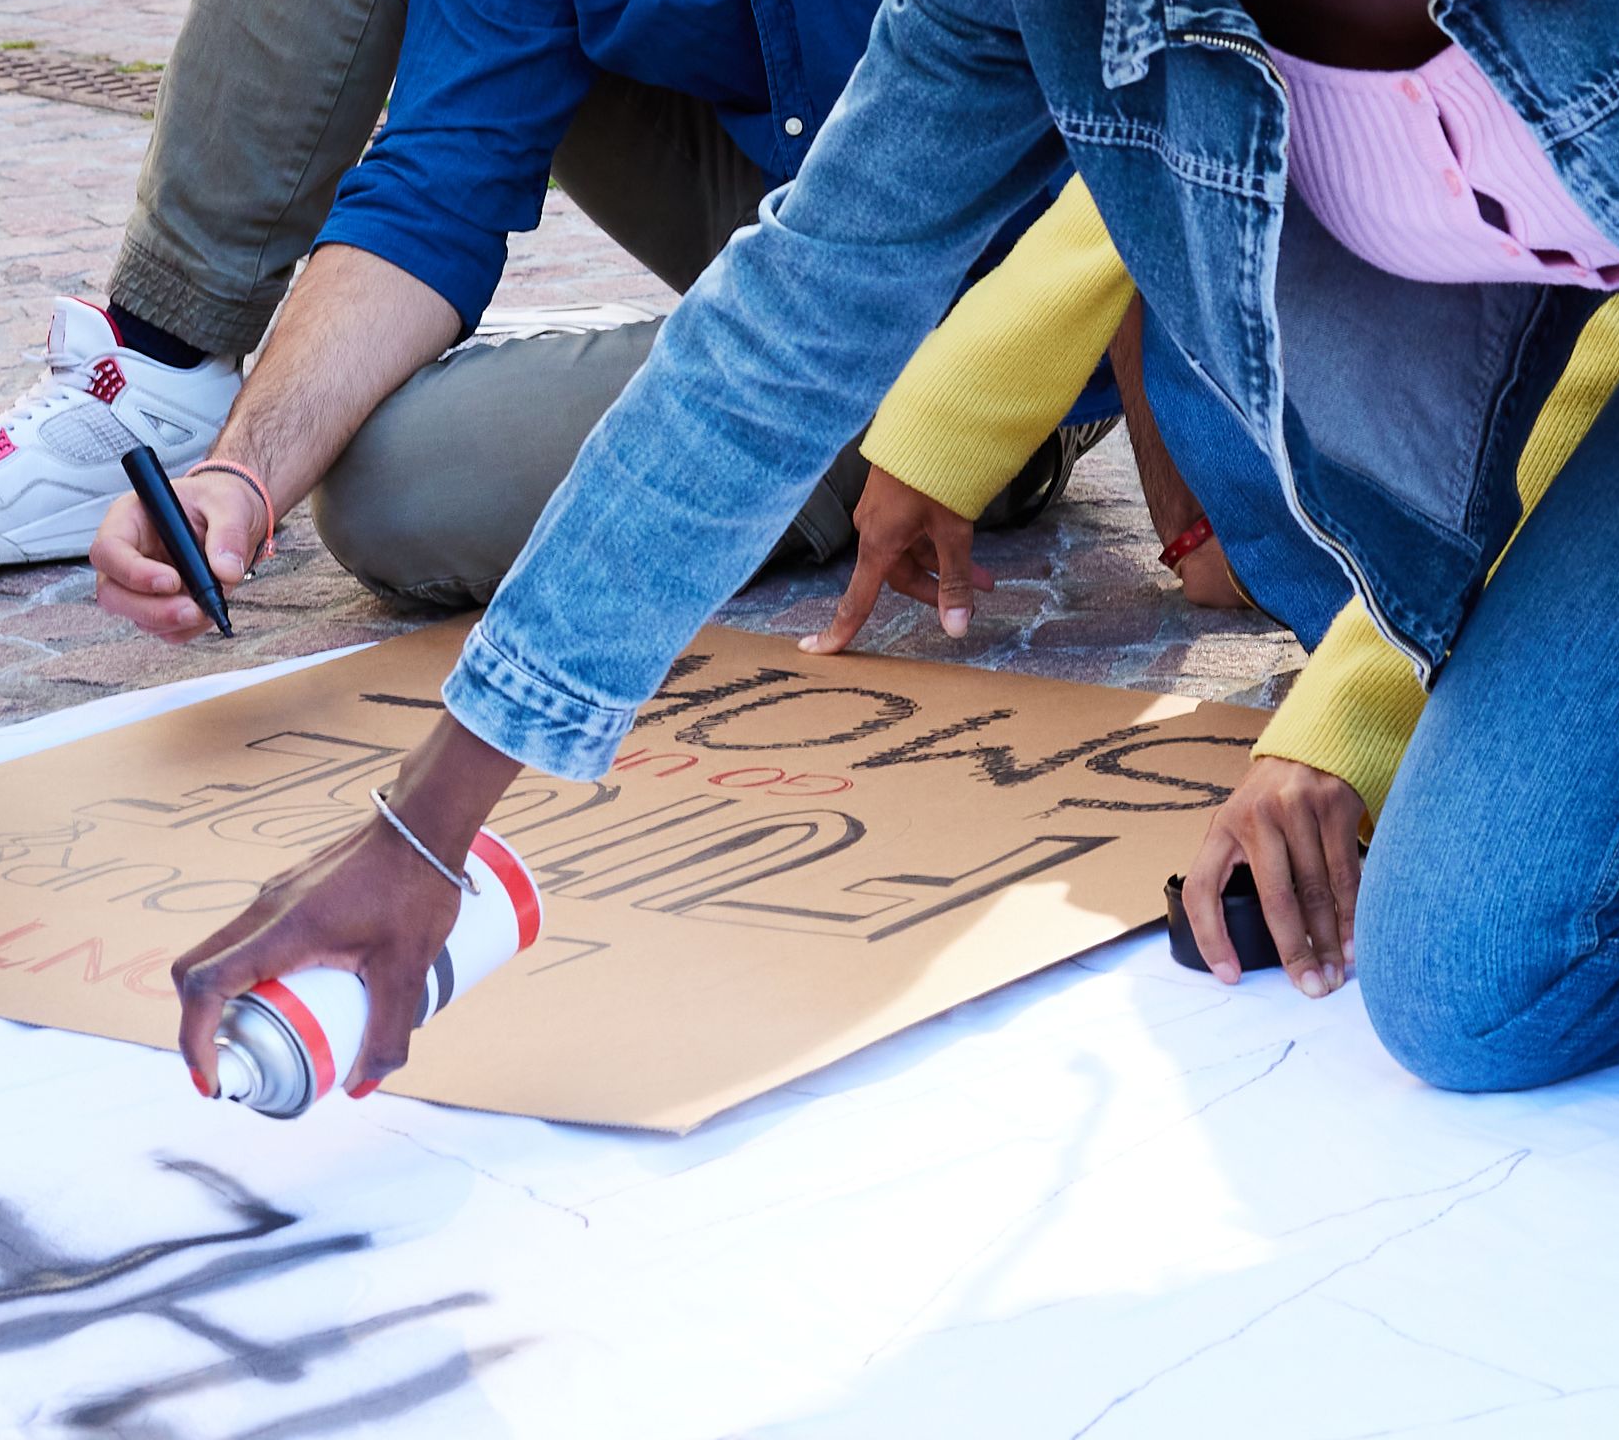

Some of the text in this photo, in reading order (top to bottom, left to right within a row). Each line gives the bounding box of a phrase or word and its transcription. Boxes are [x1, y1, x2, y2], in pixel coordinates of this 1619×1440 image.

[359, 654, 1259, 818] SMOK
[614, 746, 854, 797] GO U
[0, 846, 267, 913] OUR
